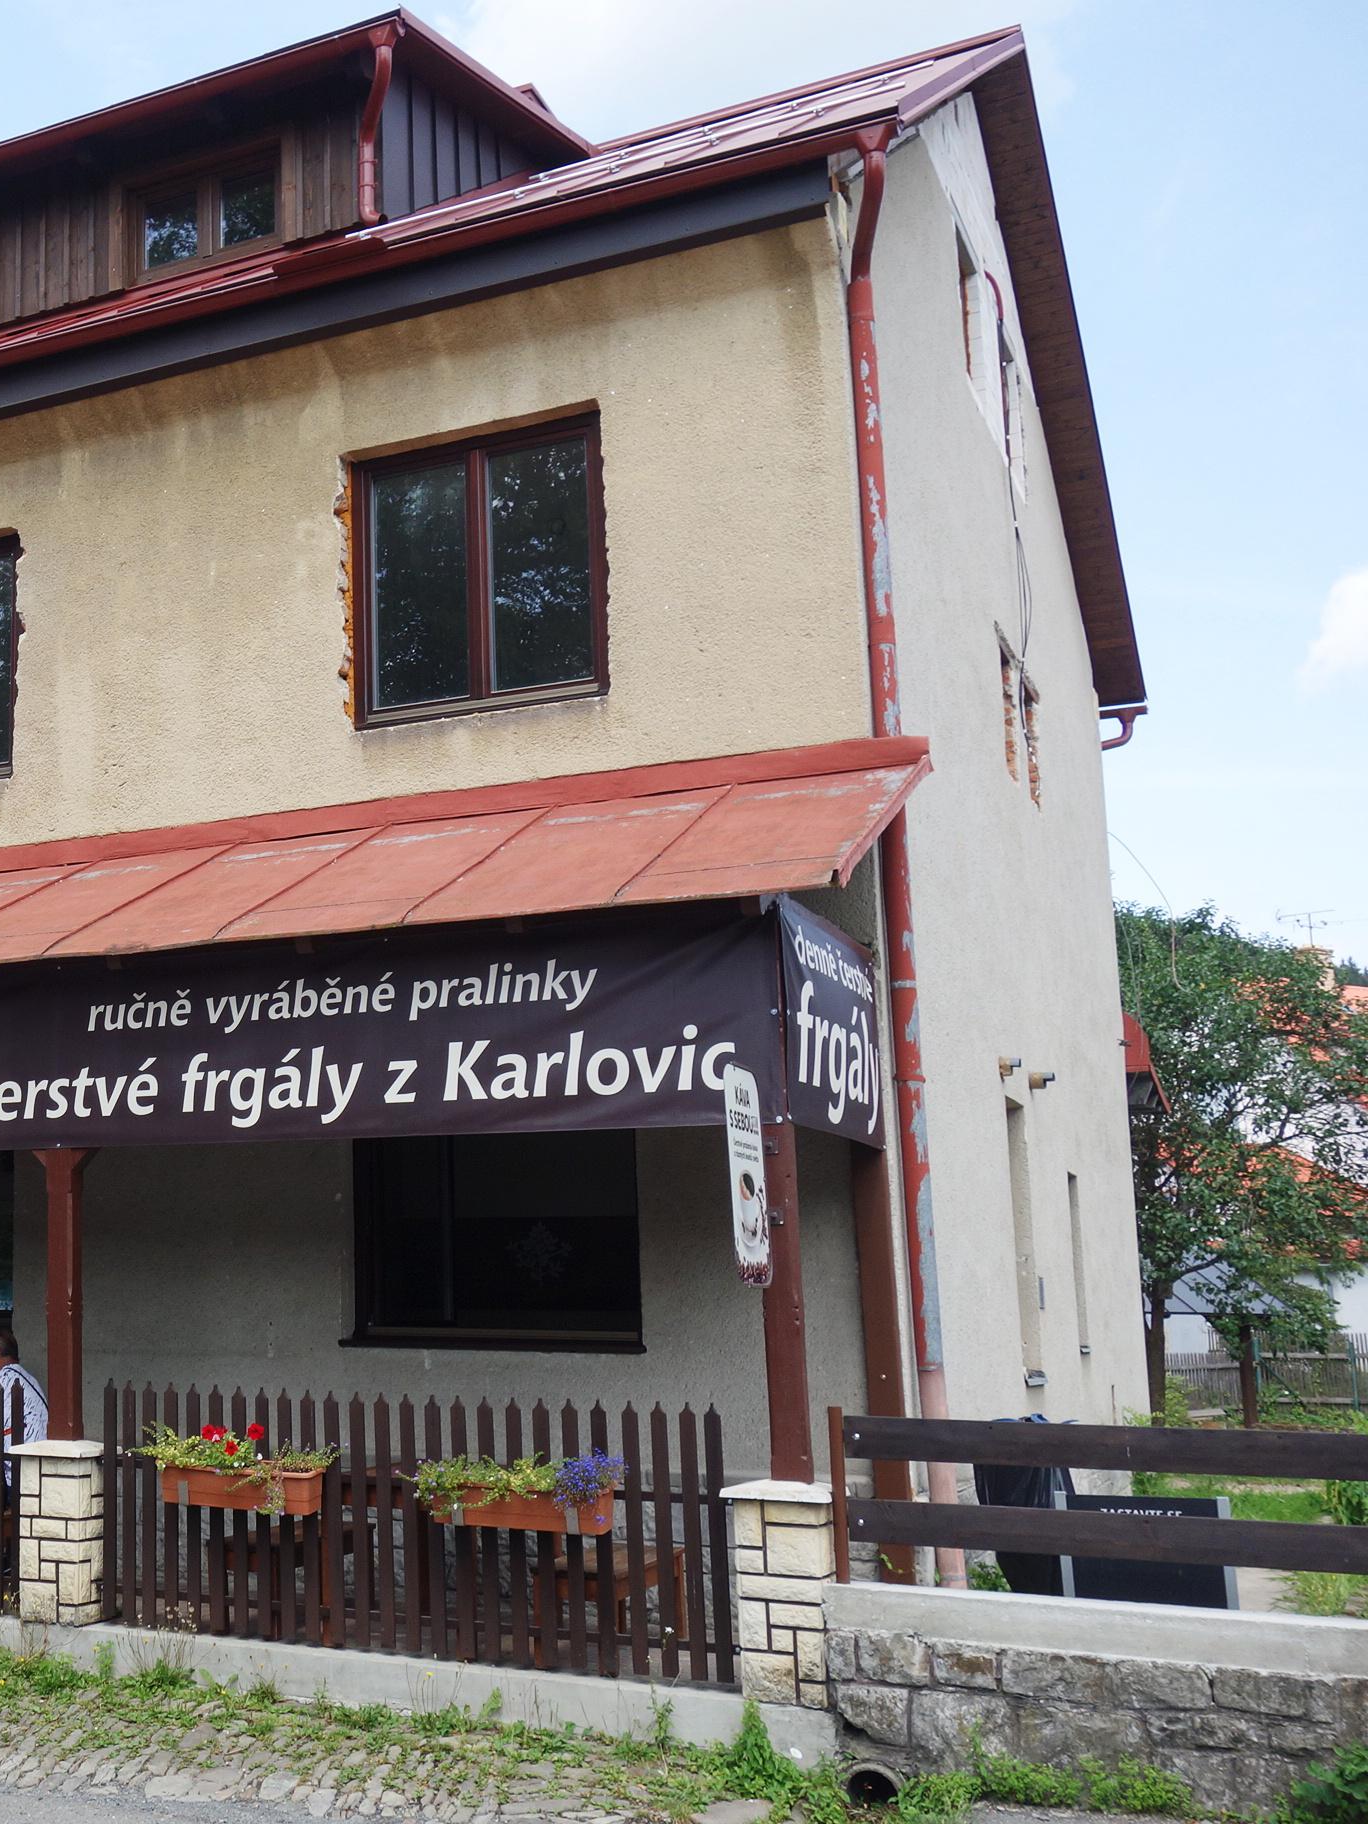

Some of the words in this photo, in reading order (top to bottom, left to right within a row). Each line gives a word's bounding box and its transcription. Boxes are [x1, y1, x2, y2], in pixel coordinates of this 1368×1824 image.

[87, 988, 191, 1032] ručně
[205, 972, 394, 1034] vyráběné
[410, 958, 598, 1019] pralinky
[795, 925, 838, 981] denně
[836, 948, 873, 1003] čerstvé
[181, 1046, 363, 1129] frgály
[383, 1060, 416, 1104] z
[443, 1024, 736, 1102] Karlovic
[734, 1083, 751, 1108] KÁVA
[797, 980, 880, 1135] frgály
